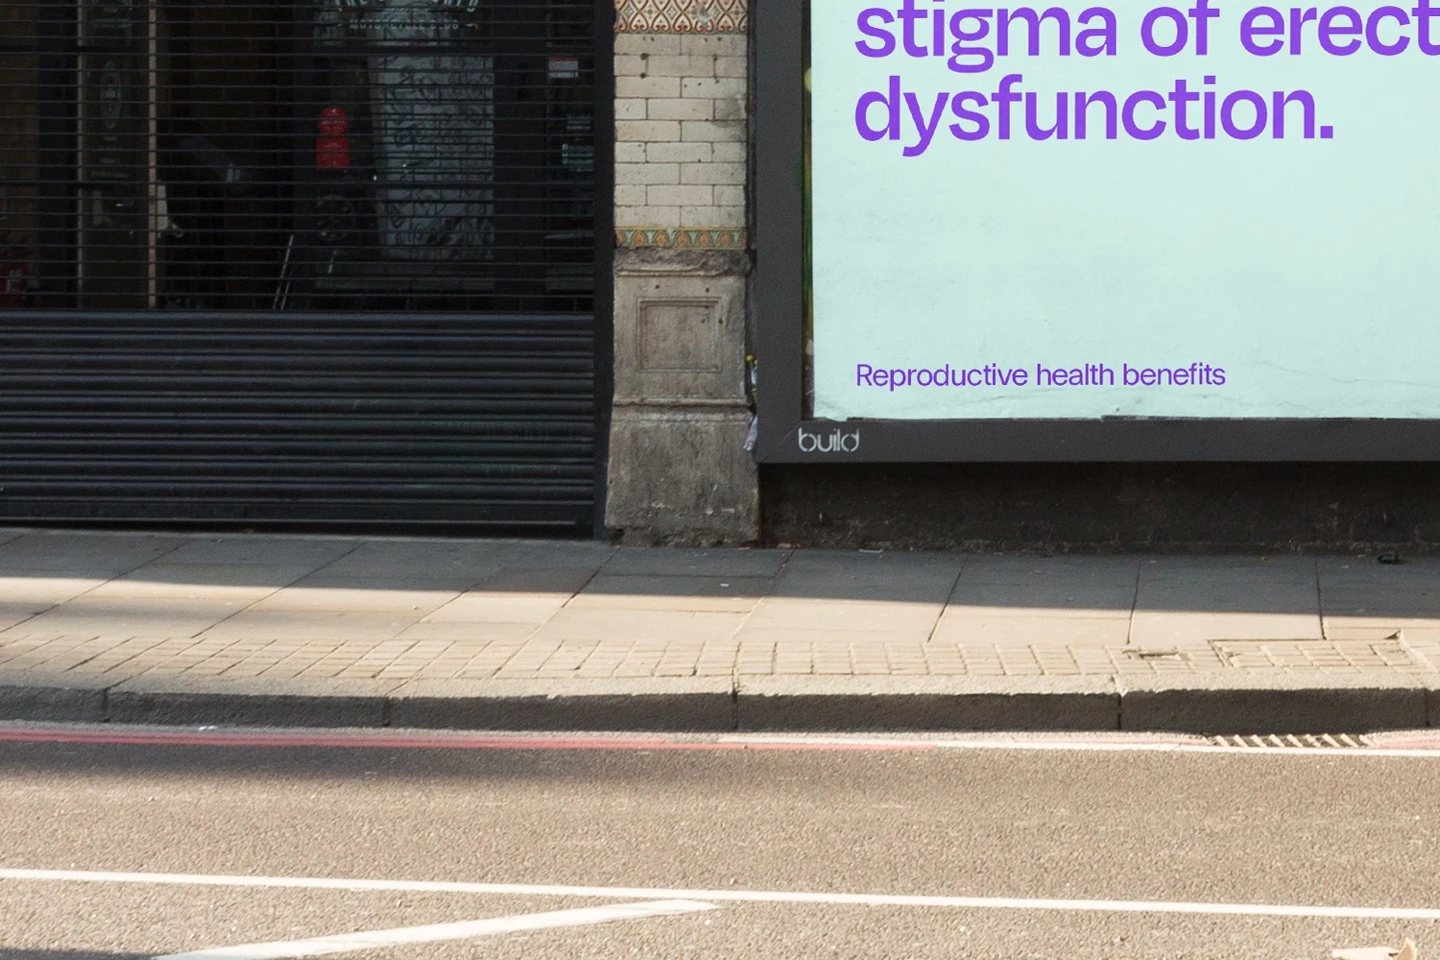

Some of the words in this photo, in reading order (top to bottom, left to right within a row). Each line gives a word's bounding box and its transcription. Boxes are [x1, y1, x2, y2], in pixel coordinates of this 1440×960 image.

[855, 74, 1335, 157] dysfunction.
[857, 364, 1028, 392] Reproductive
[1037, 363, 1115, 386] health
[1124, 363, 1226, 386] benefits
[798, 427, 860, 452] build
